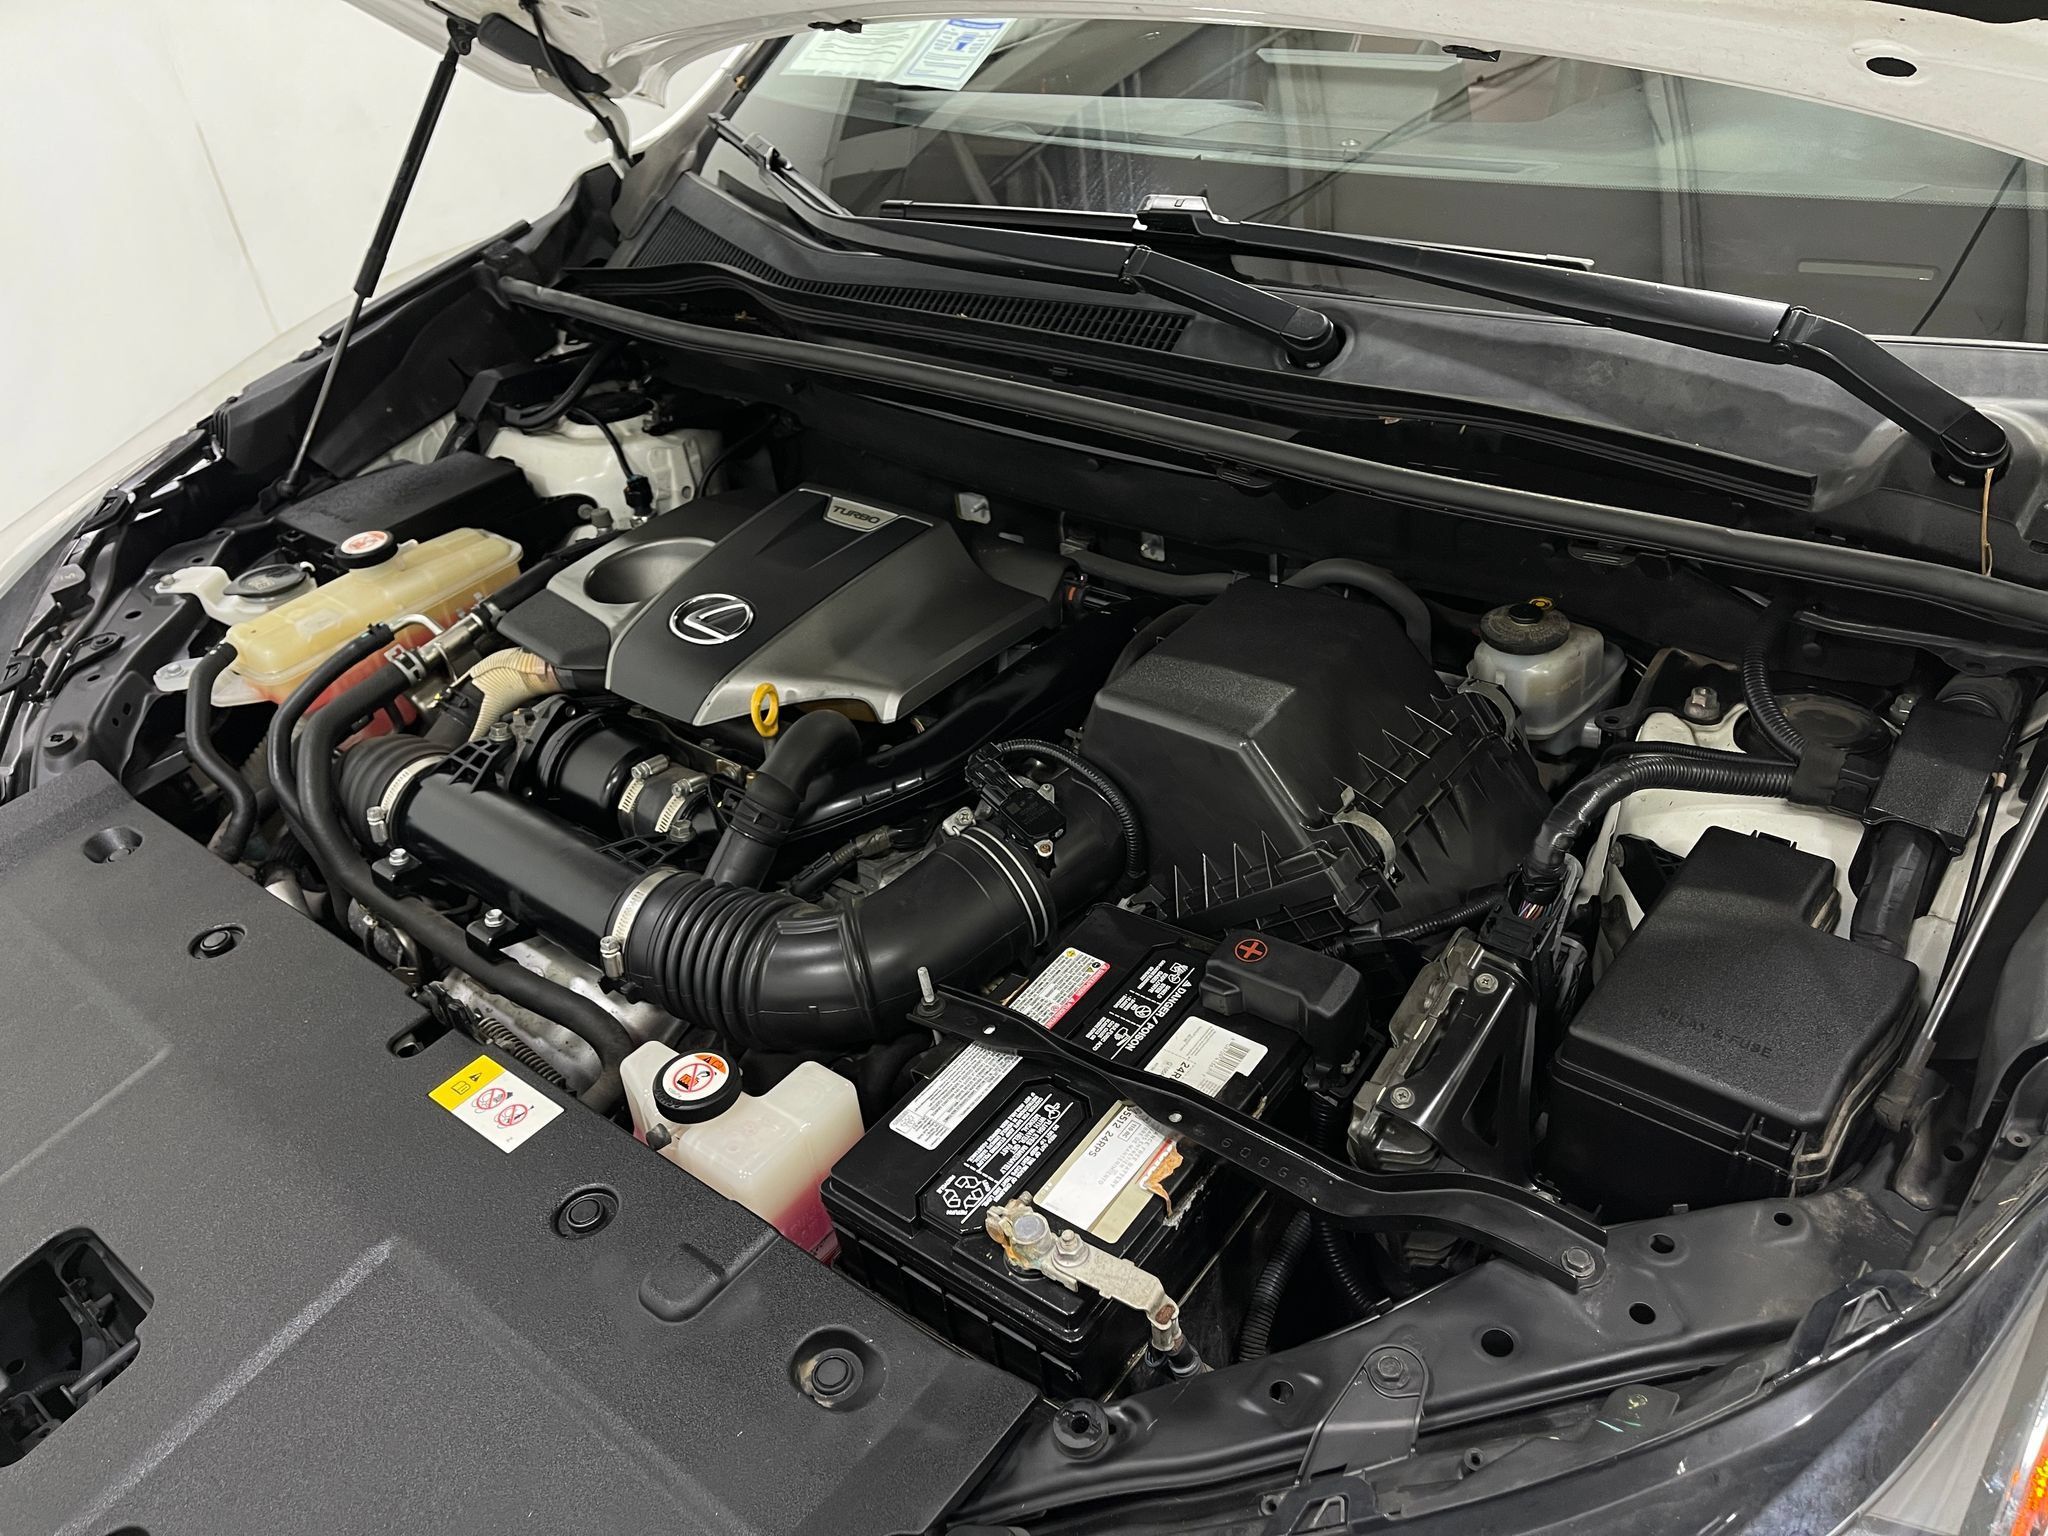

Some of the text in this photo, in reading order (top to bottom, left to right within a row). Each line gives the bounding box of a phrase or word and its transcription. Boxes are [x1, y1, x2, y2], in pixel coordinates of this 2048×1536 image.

[833, 505, 881, 524] TURBO
[1154, 986, 1187, 1019] DANGER
[1123, 1020, 1155, 1052] POISON
[1656, 1006, 1773, 1059] RELAY & FUSE
[1086, 1129, 1114, 1158] 24RPS
